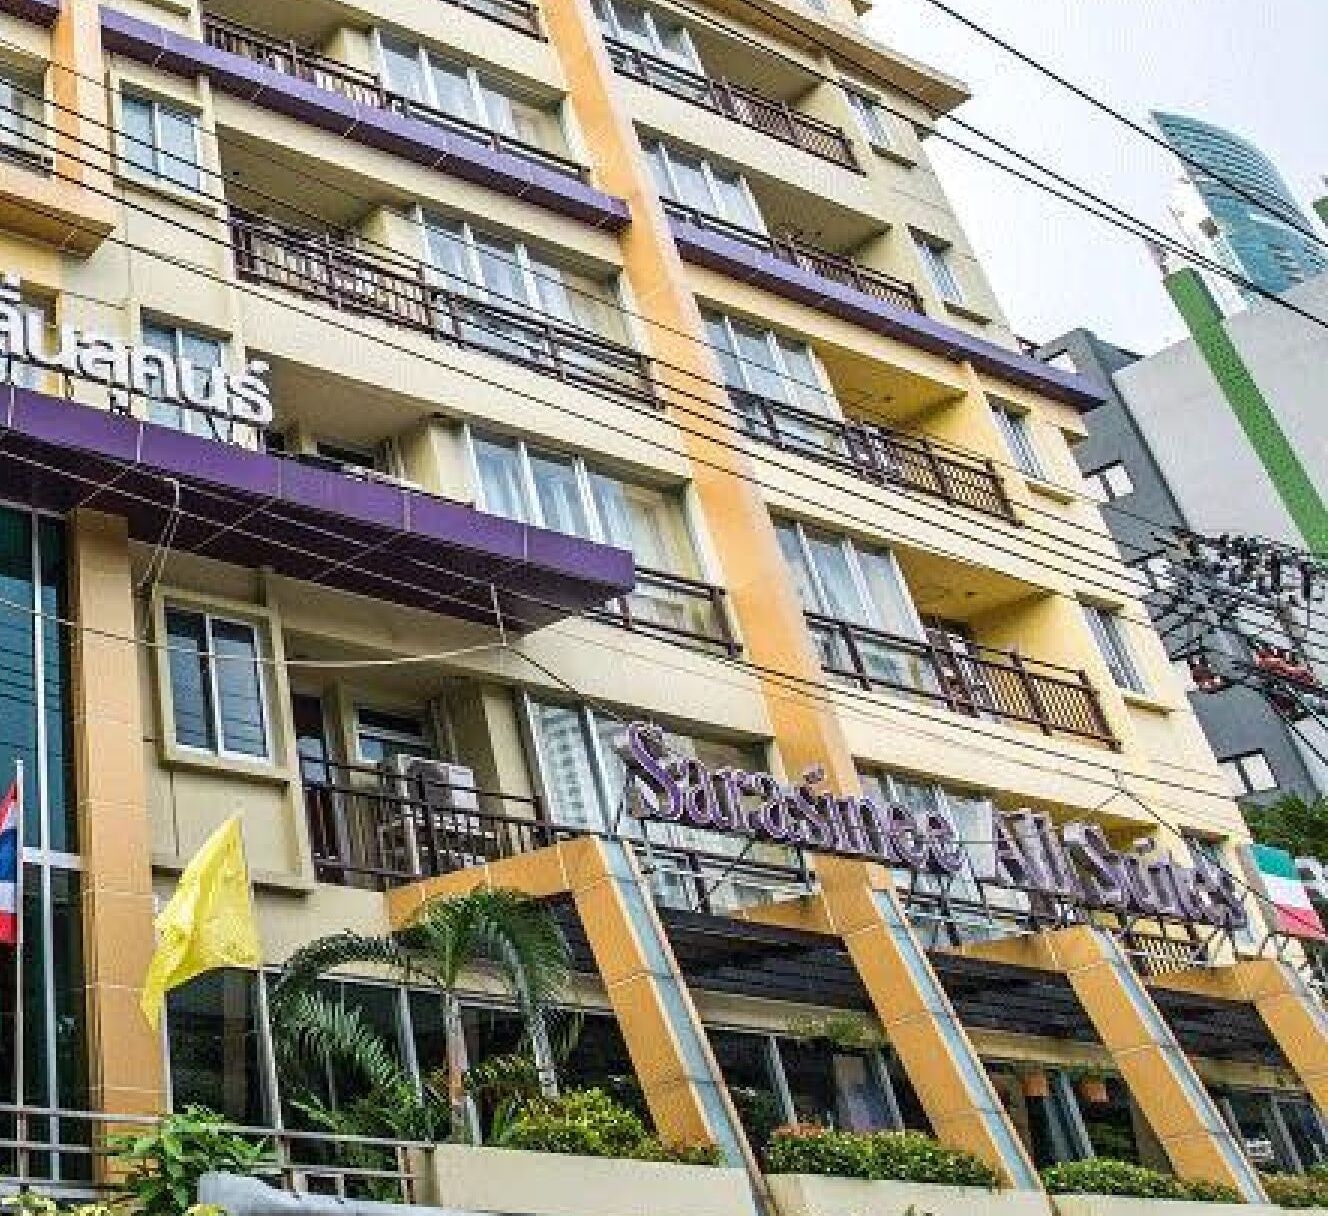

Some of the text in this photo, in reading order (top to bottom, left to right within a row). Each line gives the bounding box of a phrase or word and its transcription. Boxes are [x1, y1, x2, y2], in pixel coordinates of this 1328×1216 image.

[628, 719, 1248, 929] Sarasinee All Suites
